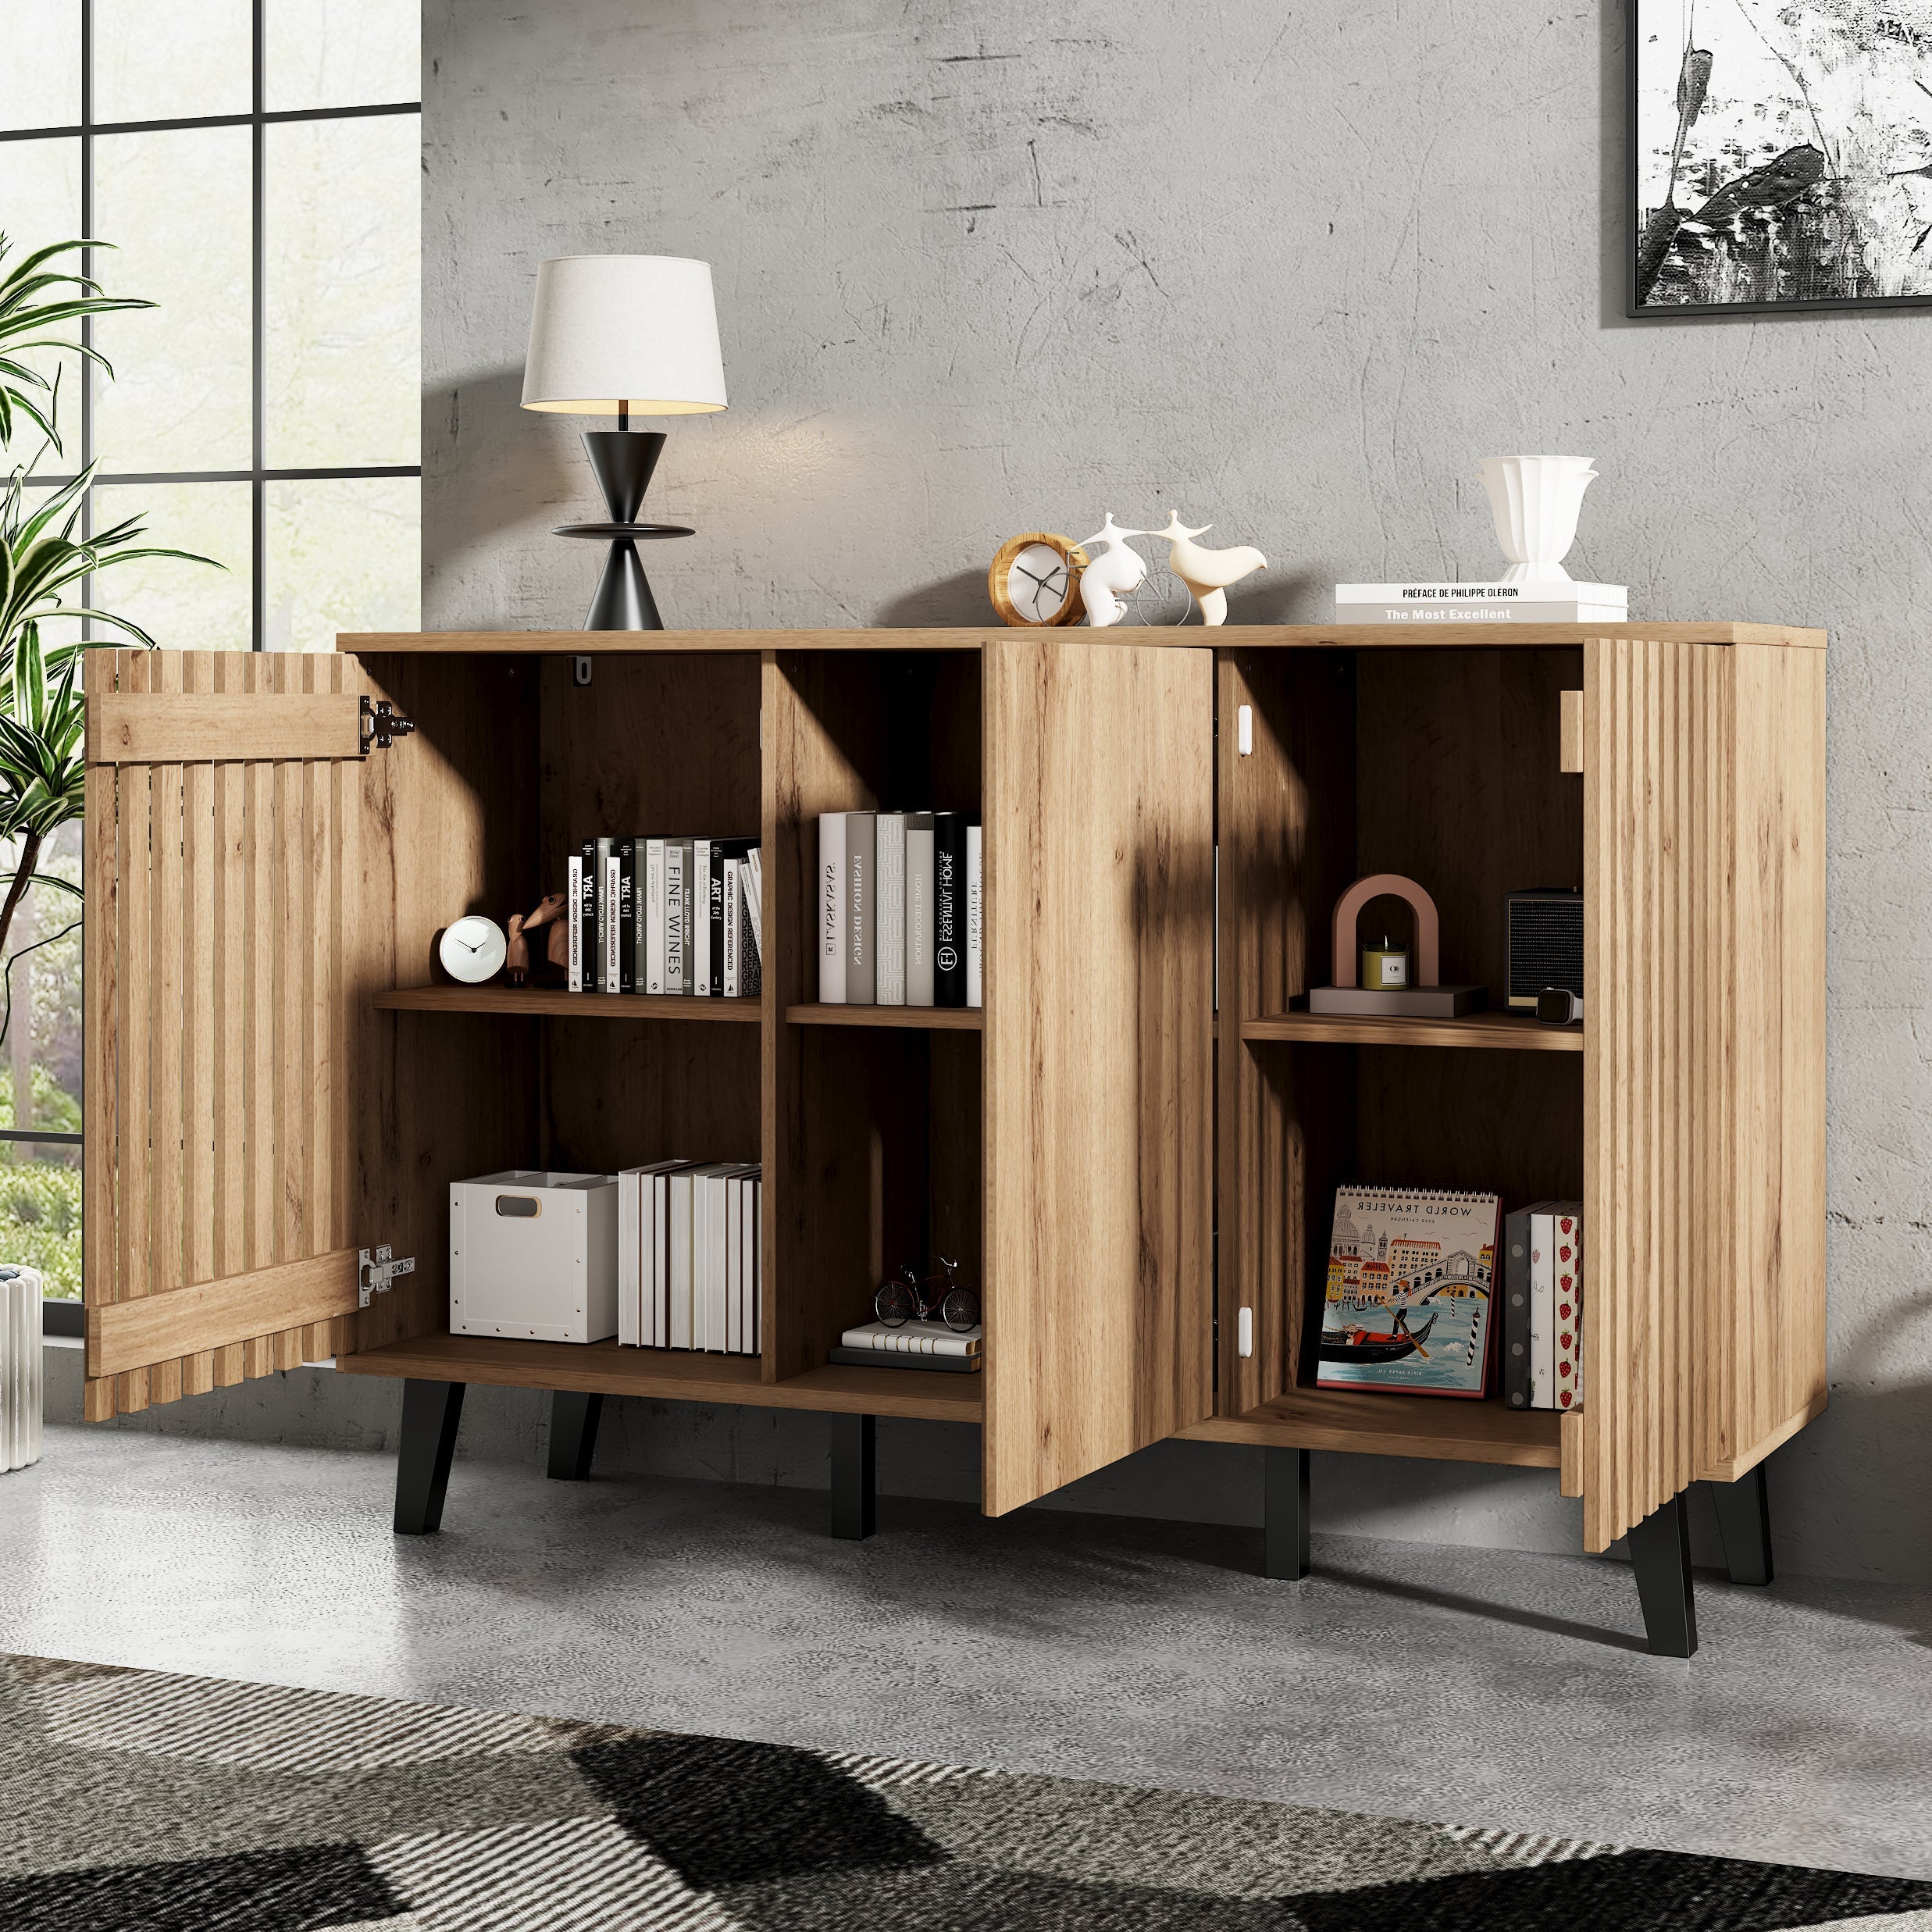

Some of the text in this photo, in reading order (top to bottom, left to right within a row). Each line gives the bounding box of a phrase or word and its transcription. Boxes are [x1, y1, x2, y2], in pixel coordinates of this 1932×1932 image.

[1403, 586, 1518, 598] PRÉFACE DE PHILIPPE OLÉRON
[1385, 608, 1512, 620] The Most Excellent
[668, 867, 680, 907] FINE
[711, 878, 721, 903] ART
[668, 915, 680, 975] WINES
